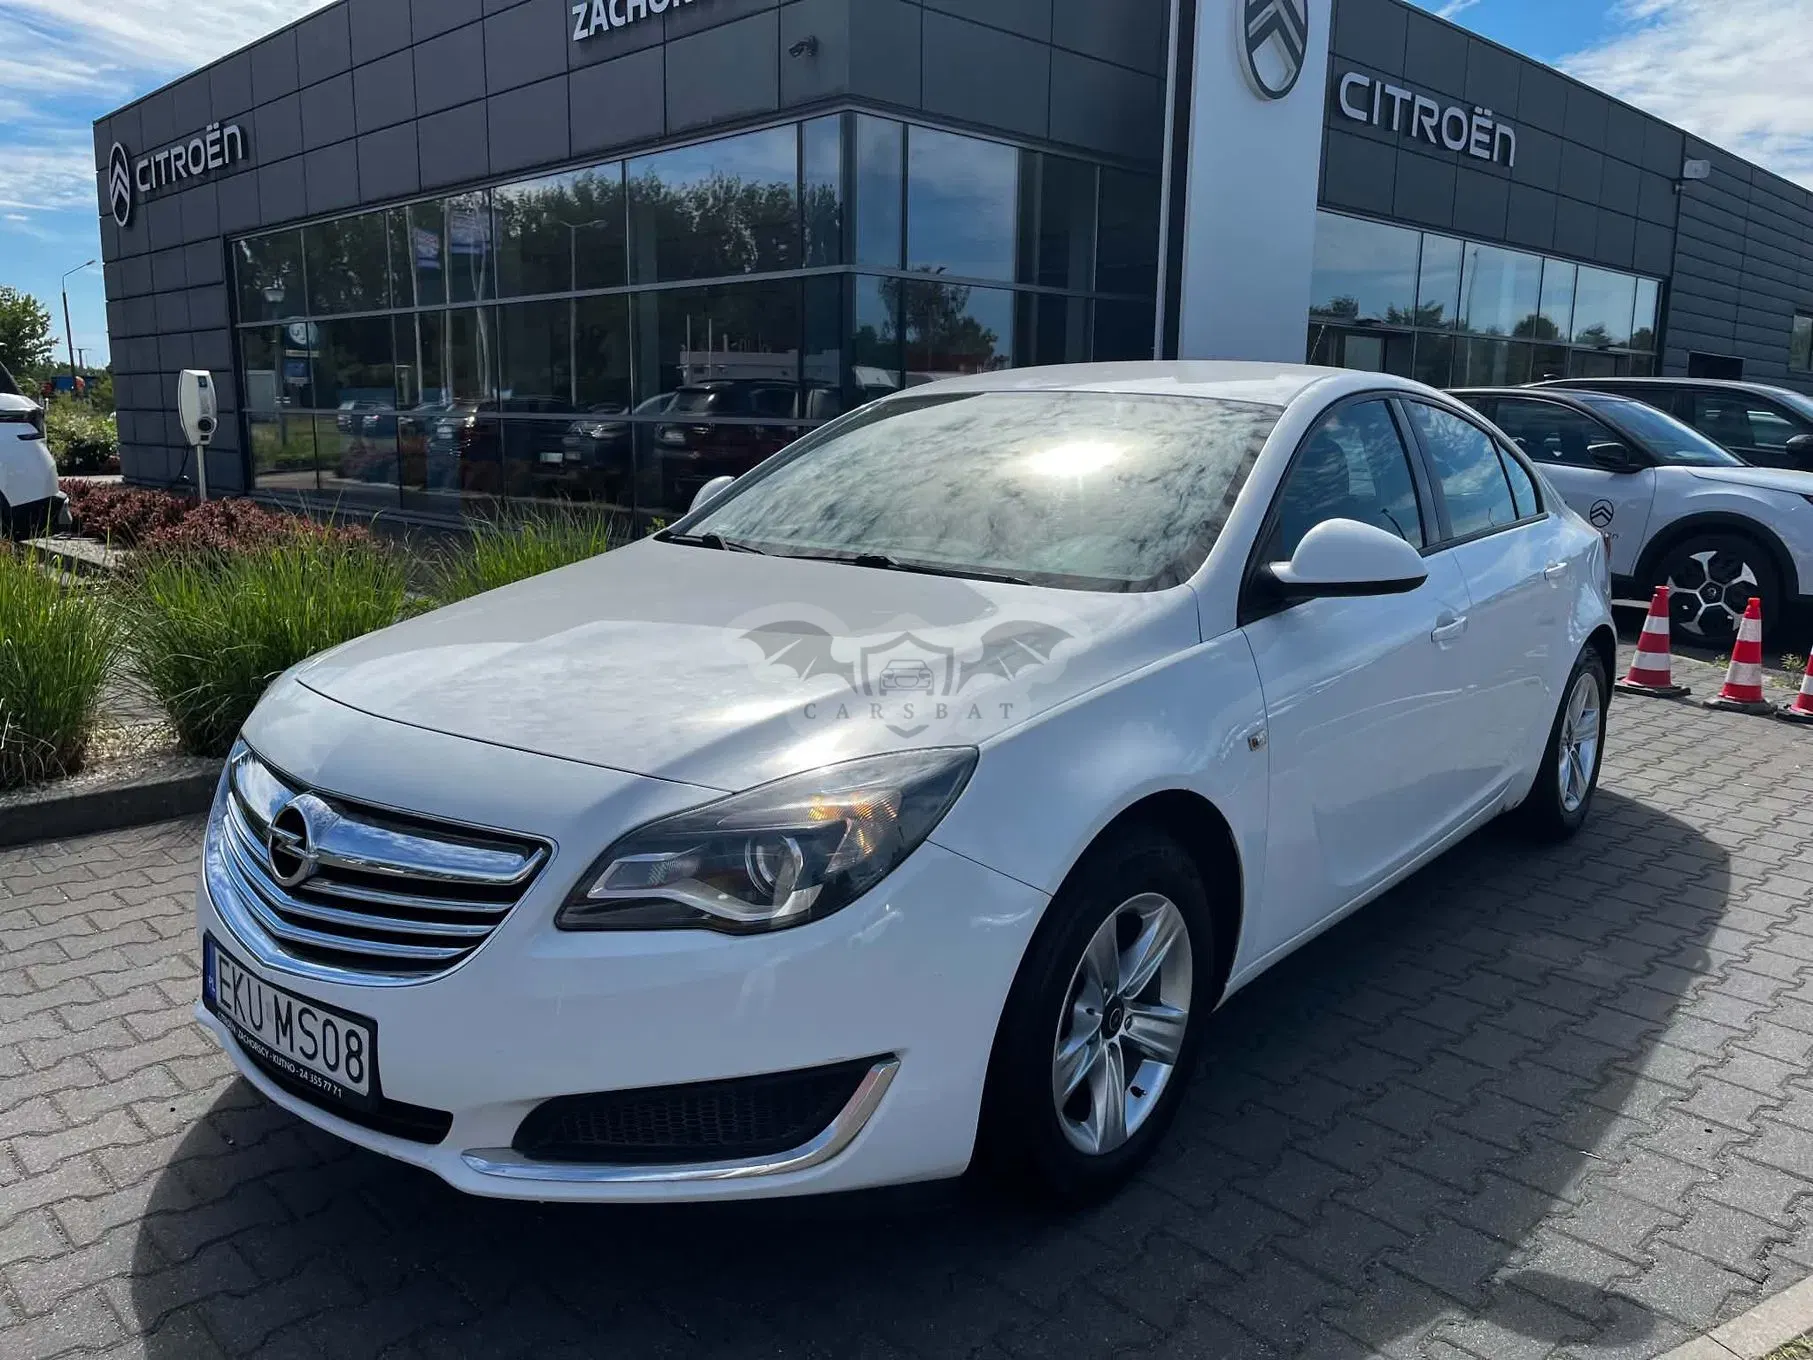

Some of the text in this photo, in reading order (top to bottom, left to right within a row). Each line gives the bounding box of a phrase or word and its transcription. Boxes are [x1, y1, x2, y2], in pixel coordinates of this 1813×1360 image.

[572, 0, 694, 41] ZACH
[218, 954, 364, 1084] EKU MS08
[272, 1053, 296, 1073] KUTNO
